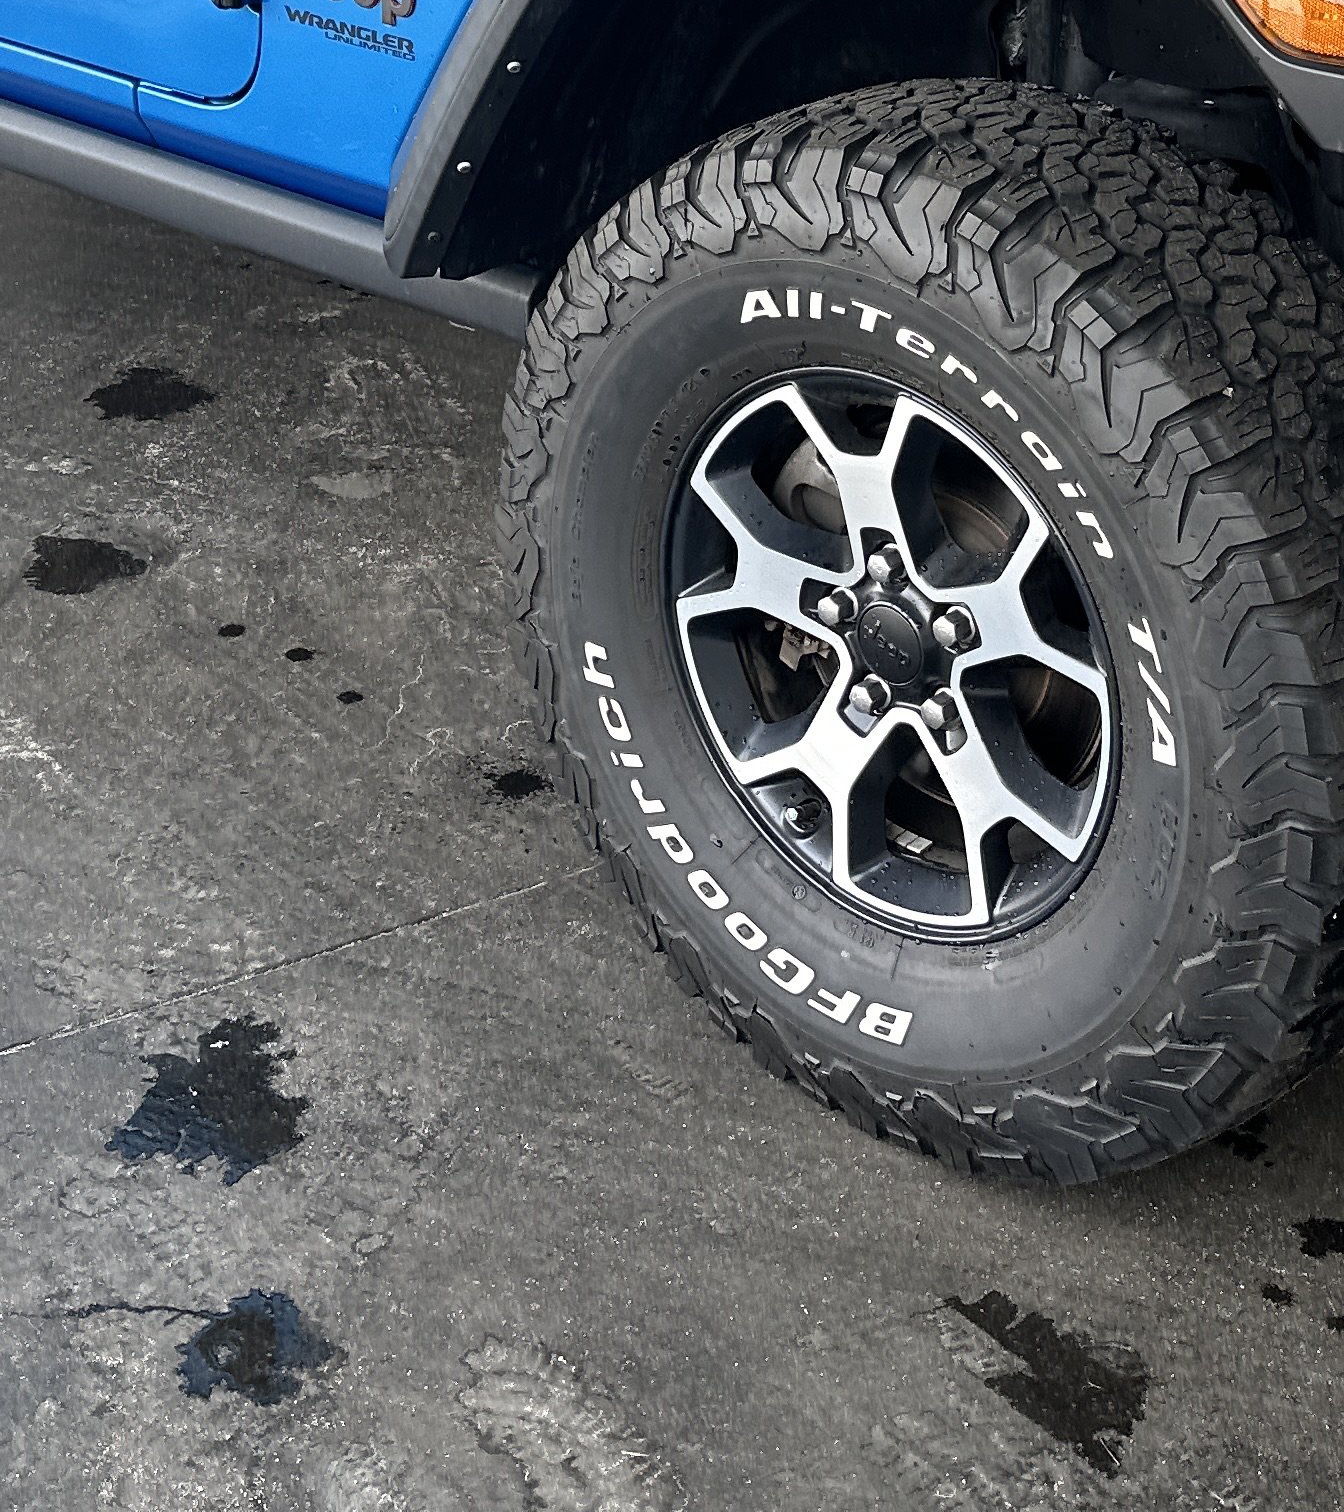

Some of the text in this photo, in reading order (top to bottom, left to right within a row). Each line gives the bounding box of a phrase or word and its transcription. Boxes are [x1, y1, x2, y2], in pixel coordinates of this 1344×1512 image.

[283, 4, 414, 55] WRANGLER
[324, 31, 416, 62] UNLIMITED
[739, 288, 1181, 768] All-Terrain T/A
[582, 641, 914, 1047] BFGoodrich
